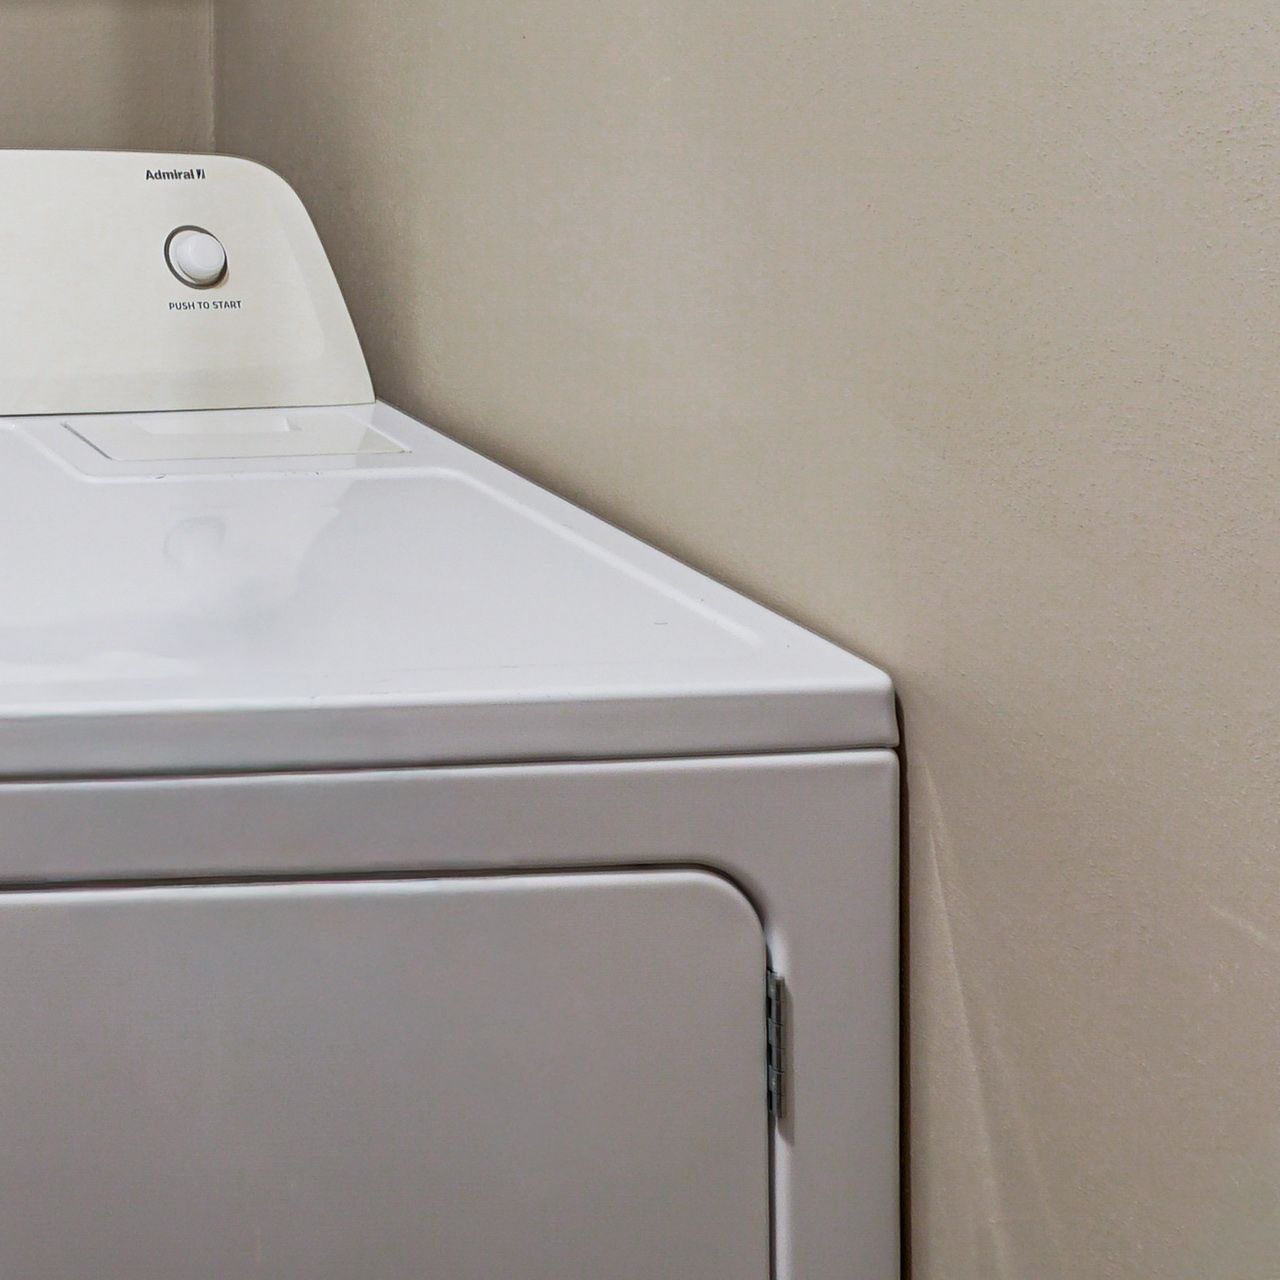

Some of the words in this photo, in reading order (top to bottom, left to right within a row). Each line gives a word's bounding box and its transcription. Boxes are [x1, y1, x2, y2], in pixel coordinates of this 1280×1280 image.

[145, 169, 194, 180] Admiral
[169, 301, 195, 310] PUSH
[198, 301, 210, 310] TO
[212, 300, 242, 309] START
